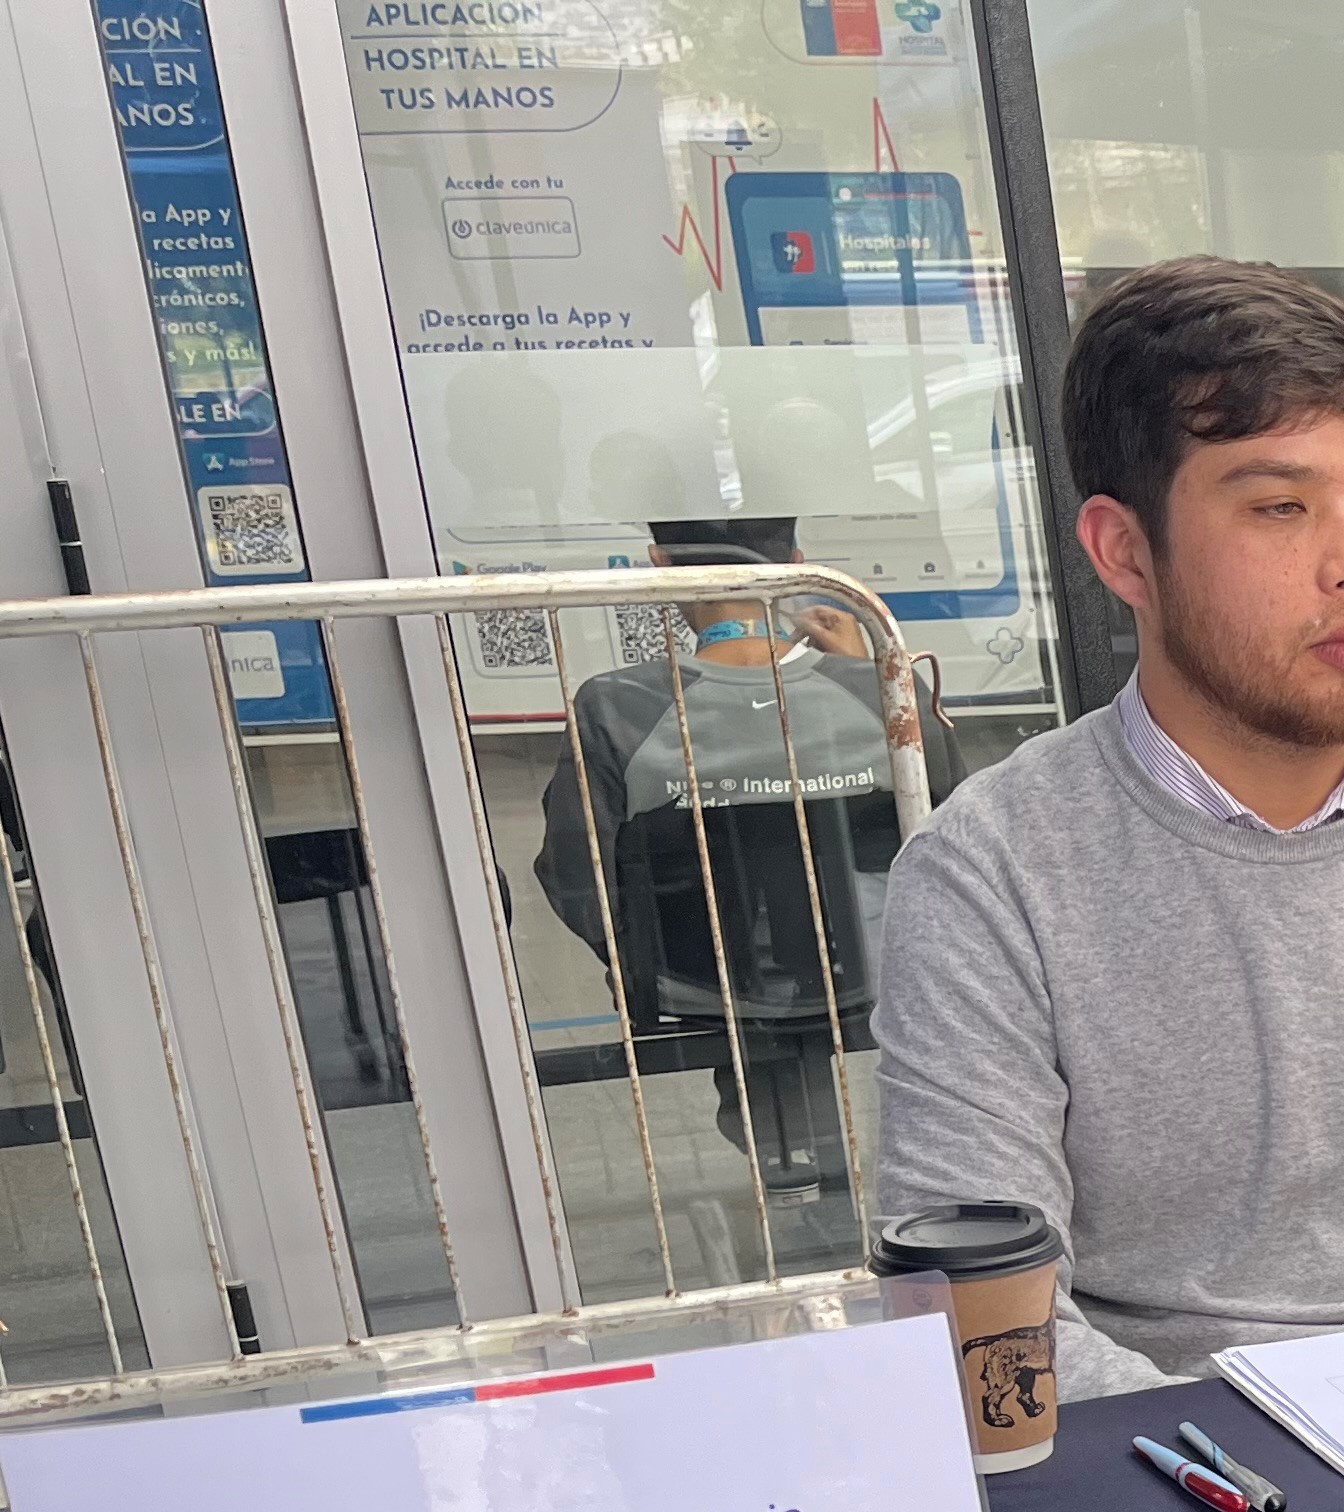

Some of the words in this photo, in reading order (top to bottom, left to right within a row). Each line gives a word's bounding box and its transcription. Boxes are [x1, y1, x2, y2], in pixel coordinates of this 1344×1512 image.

[101, 12, 182, 41] CIÓN
[364, 47, 507, 72] HOSPITAL
[517, 47, 560, 70] EN
[154, 62, 198, 86] EN
[380, 87, 436, 110] TUS
[444, 86, 555, 109] MANOS
[445, 174, 504, 191] Accede
[511, 178, 541, 189] con
[546, 175, 563, 189] tu
[165, 203, 211, 227] App
[218, 207, 232, 227] y
[152, 233, 235, 251] recetas
[419, 308, 530, 332] ¡Descarga
[537, 305, 559, 326] la
[568, 306, 612, 329] App
[618, 311, 631, 329] y
[183, 349, 197, 366] y
[205, 341, 257, 361] más!
[407, 335, 484, 354] accede
[514, 337, 547, 350] tus
[555, 335, 634, 350] recetas
[211, 401, 242, 422] EN
[743, 767, 875, 794] International
